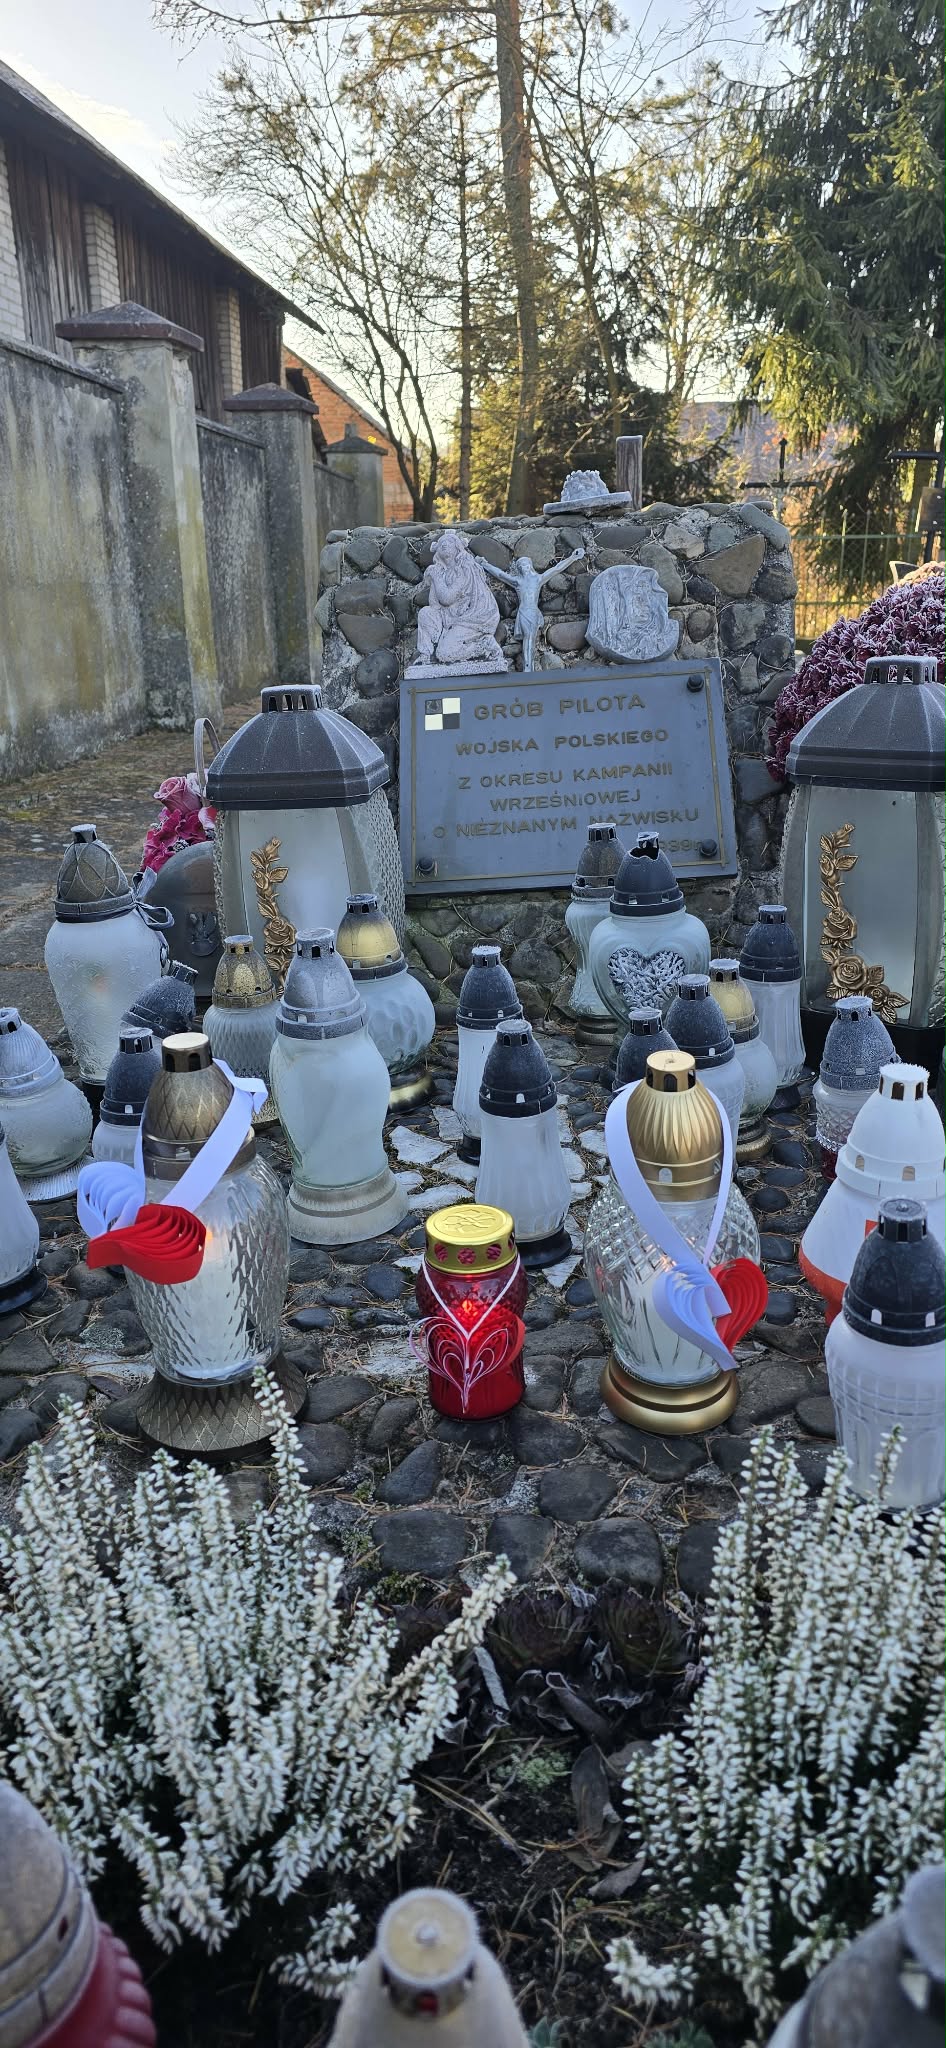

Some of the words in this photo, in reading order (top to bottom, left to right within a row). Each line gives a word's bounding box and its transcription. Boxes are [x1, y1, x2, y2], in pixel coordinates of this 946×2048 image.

[474, 697, 544, 720] GRÓB
[559, 694, 646, 715] PILOTA
[455, 737, 539, 756] WOJSKA
[554, 728, 669, 749] POLSKIEGO
[457, 776, 472, 790] Z
[480, 769, 563, 788] OKRESU
[573, 761, 673, 782] KAMPANII
[490, 789, 641, 812] WRZEŚNIOWEJ
[433, 826, 446, 839] O
[456, 816, 577, 838] NIEZNANYM
[589, 808, 699, 828] NAZWISKU
